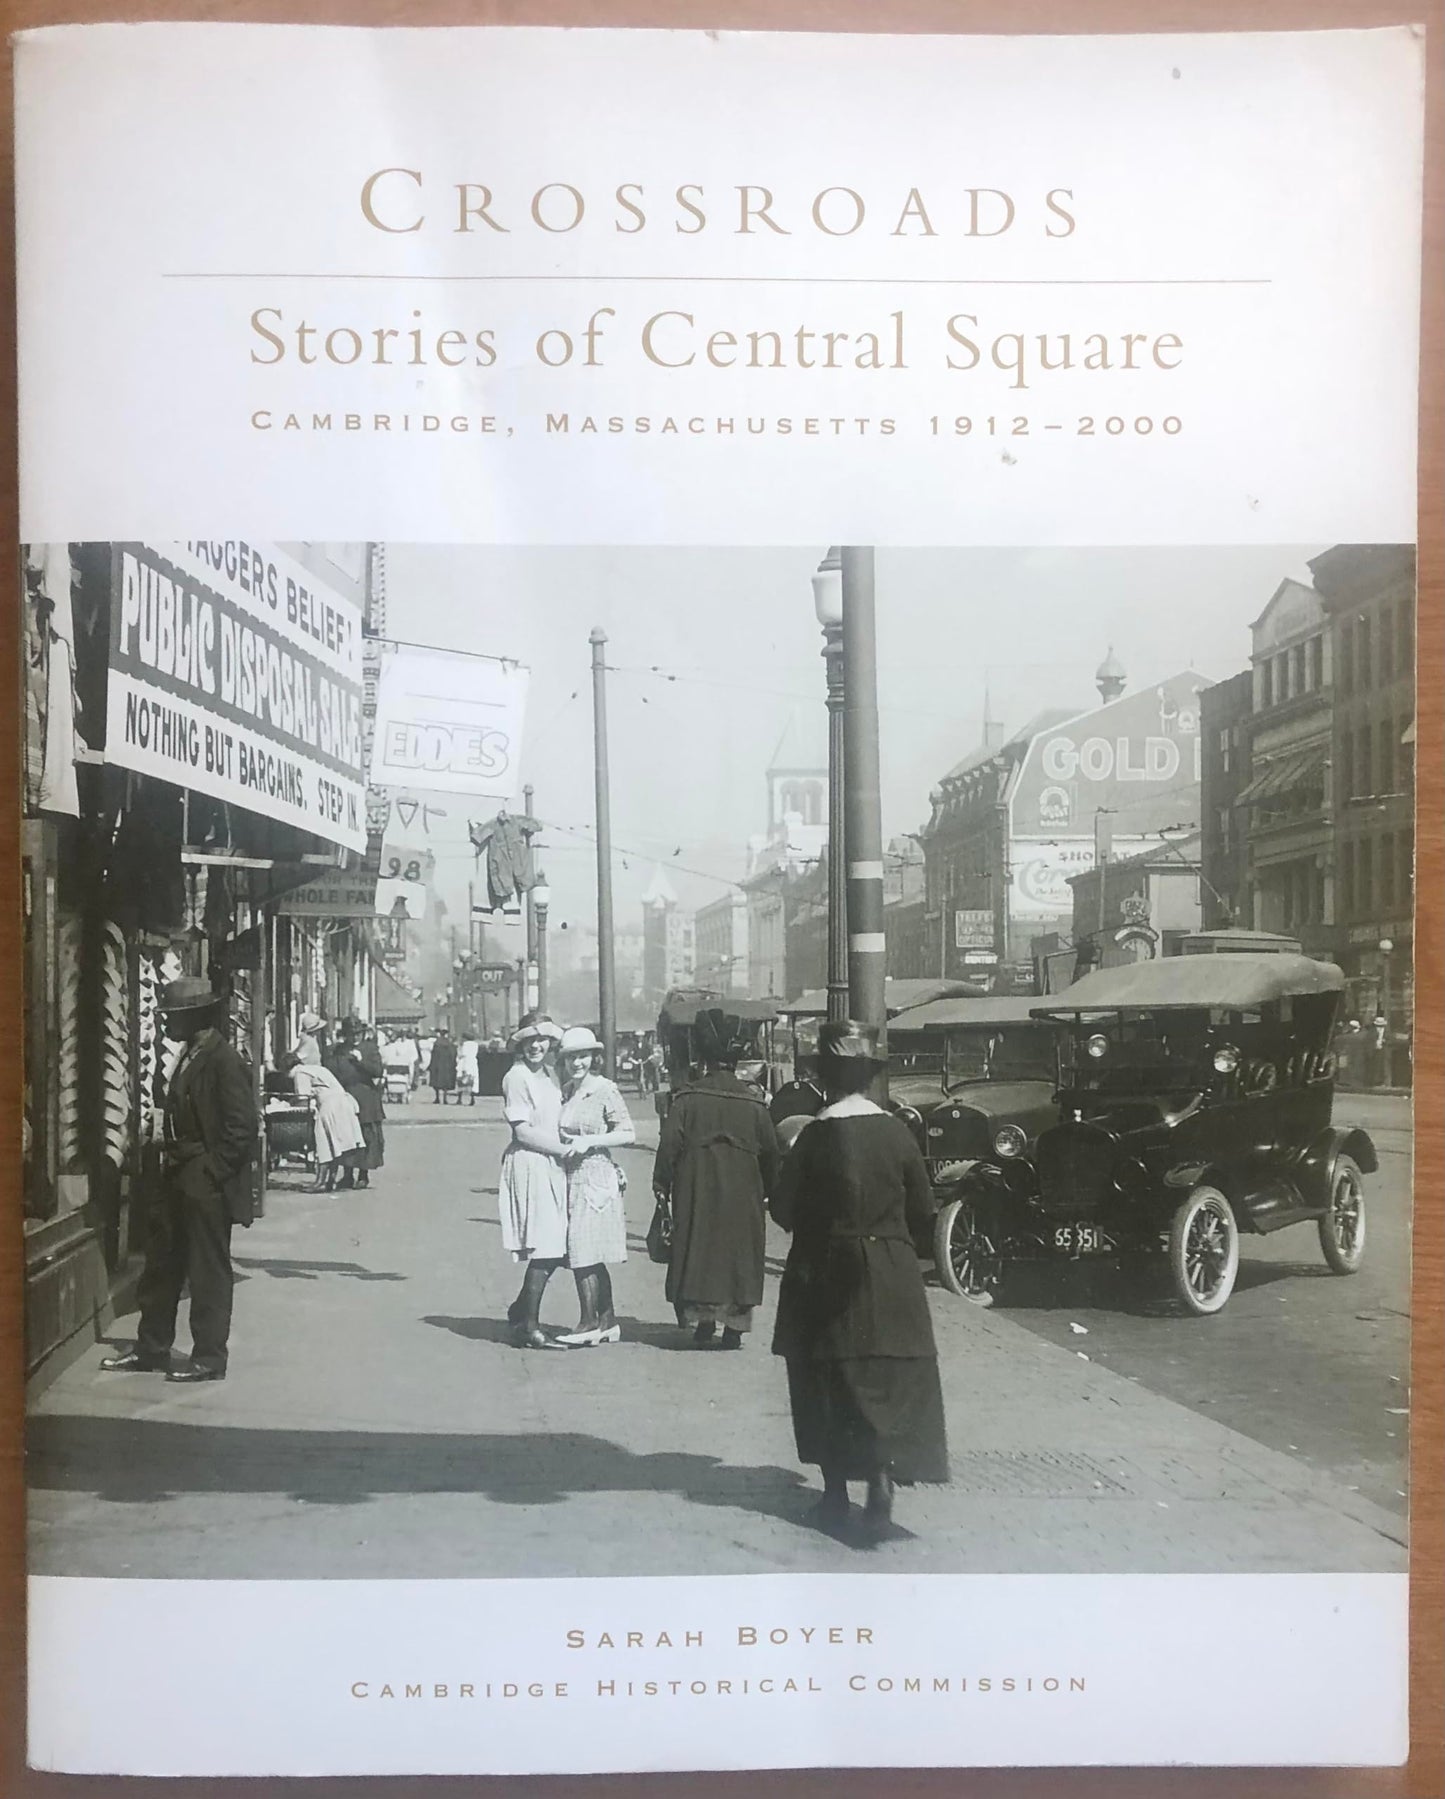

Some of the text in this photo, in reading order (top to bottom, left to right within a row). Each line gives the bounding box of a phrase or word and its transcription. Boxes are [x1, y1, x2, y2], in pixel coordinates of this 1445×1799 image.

[360, 168, 1077, 239] CROSSROADS
[250, 306, 1184, 389] Stories of Central Square
[251, 410, 514, 437] CAMBRIDGE,
[546, 413, 896, 435] MASSACHUSETTS
[119, 551, 362, 771] PUBLIC DISPOSAL SALE
[125, 691, 200, 767] NOTHING
[205, 725, 233, 780] BUT
[318, 776, 343, 825] STEP
[1042, 736, 1180, 782] GOLD
[388, 857, 421, 882] 98
[1055, 1227, 1072, 1247] 65
[566, 1626, 874, 1649] SARAH BOYER
[350, 1674, 1086, 1699] CAMBRIDGE HISTORICAL COMMISSION
